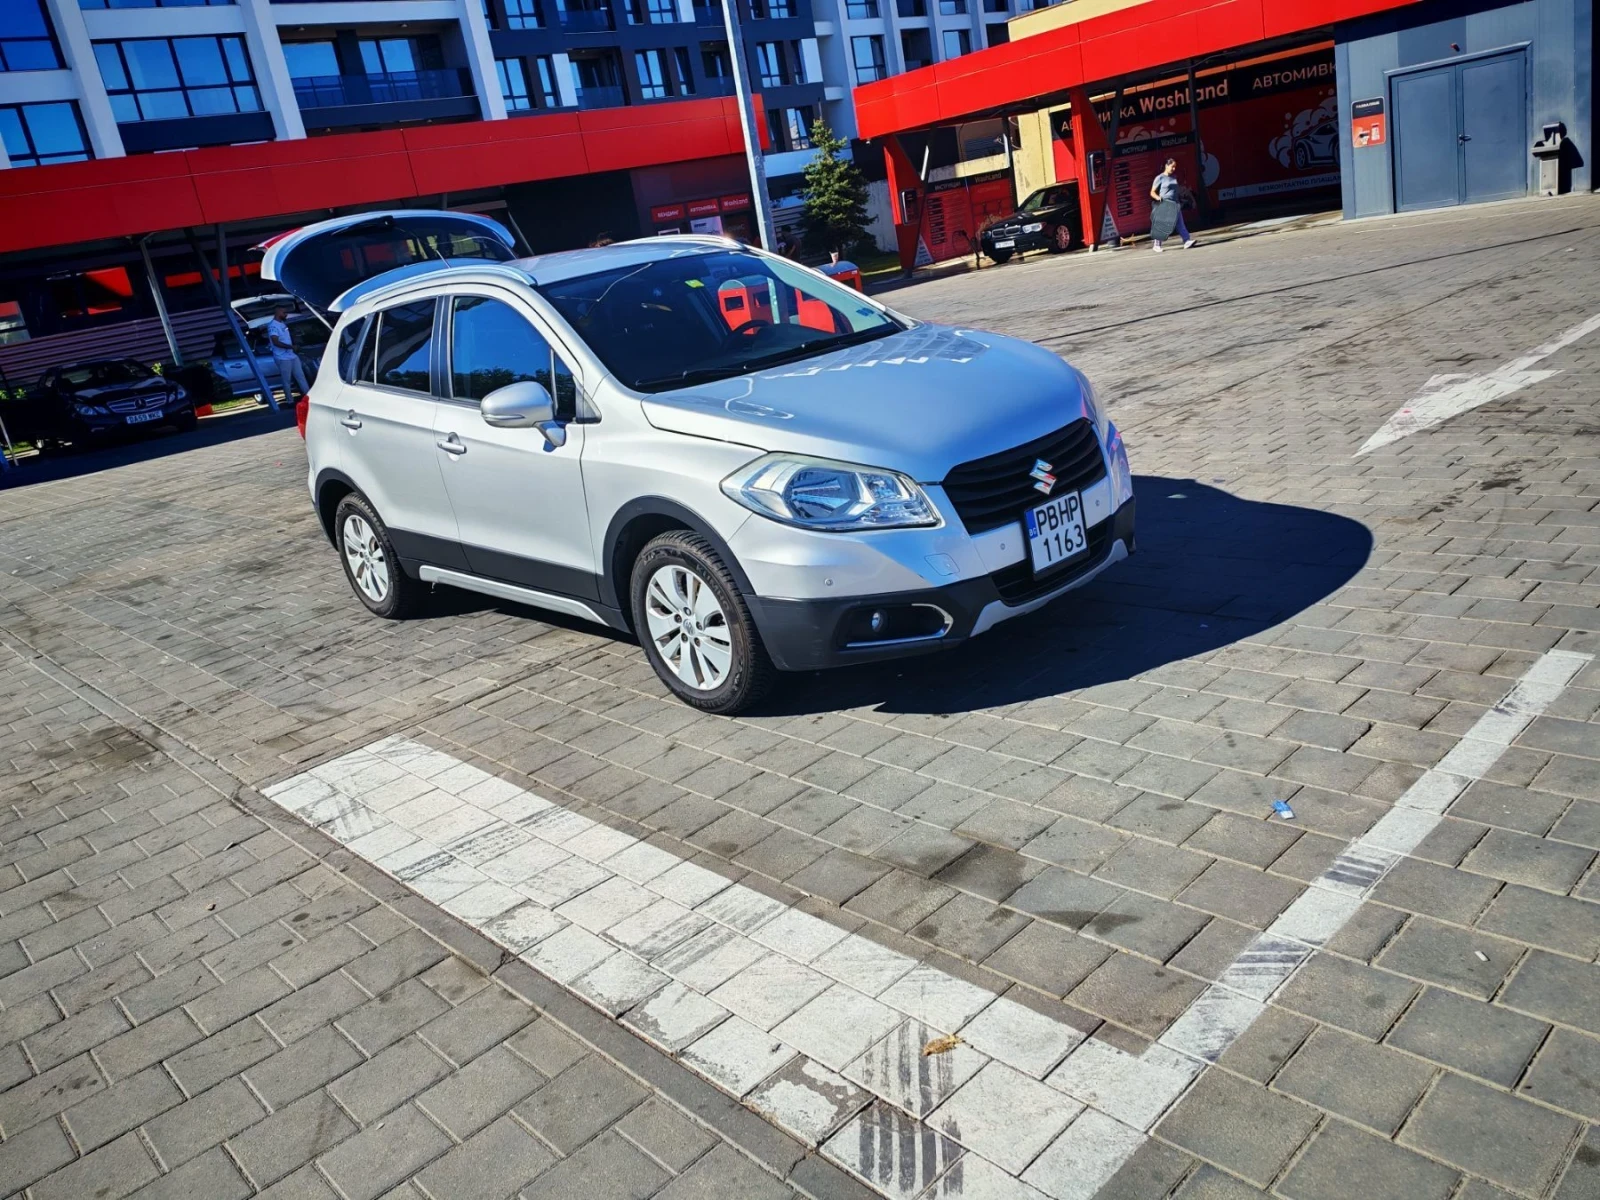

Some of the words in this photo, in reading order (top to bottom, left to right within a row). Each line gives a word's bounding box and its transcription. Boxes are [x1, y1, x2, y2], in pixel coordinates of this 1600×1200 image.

[1028, 527, 1038, 537] BG
[1035, 495, 1079, 535] PBHP
[1043, 523, 1084, 562] 1163
